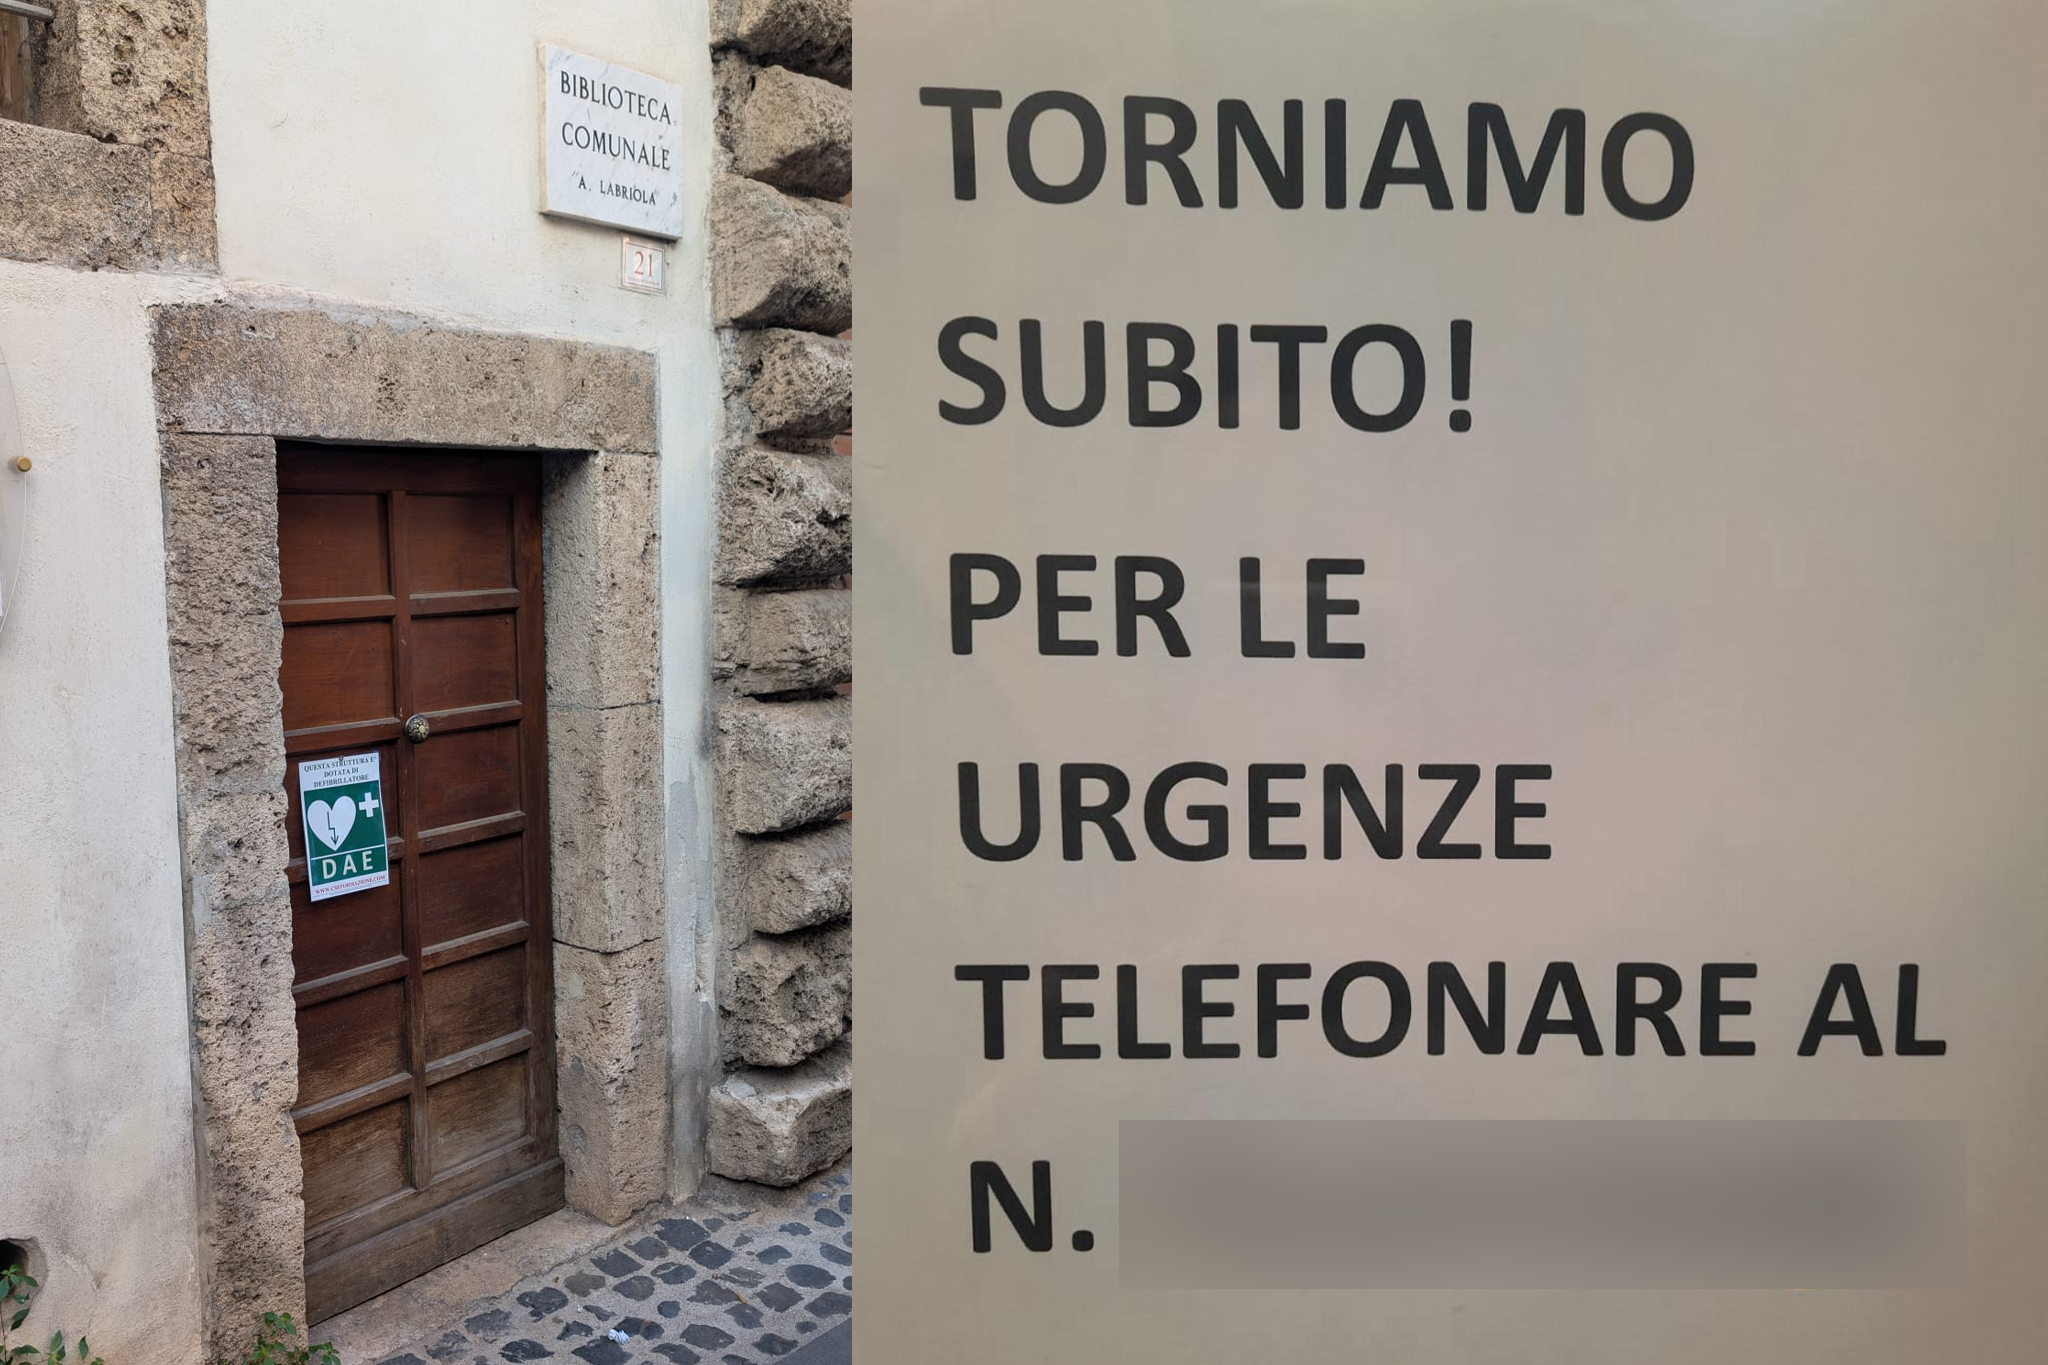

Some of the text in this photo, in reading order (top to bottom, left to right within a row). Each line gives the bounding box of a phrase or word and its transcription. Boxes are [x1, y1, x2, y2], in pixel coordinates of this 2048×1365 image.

[560, 70, 671, 125] BIBLIOTECA
[562, 121, 670, 171] COMUNALE
[920, 87, 1694, 221] TORNIAMO
[633, 250, 654, 277] 21
[938, 316, 1473, 433] SUBITO!
[950, 553, 1365, 659] PER LE
[304, 763, 330, 772] QUESTA
[331, 758, 369, 768] STRUTTURA
[314, 774, 369, 787] DEFIBRILLATORE
[324, 769, 350, 778] DOTATA
[958, 762, 1552, 862] URGENZE
[322, 850, 373, 880] DAE
[955, 961, 1946, 1060] TELEFONARE AL
[970, 1160, 1095, 1253] N.
